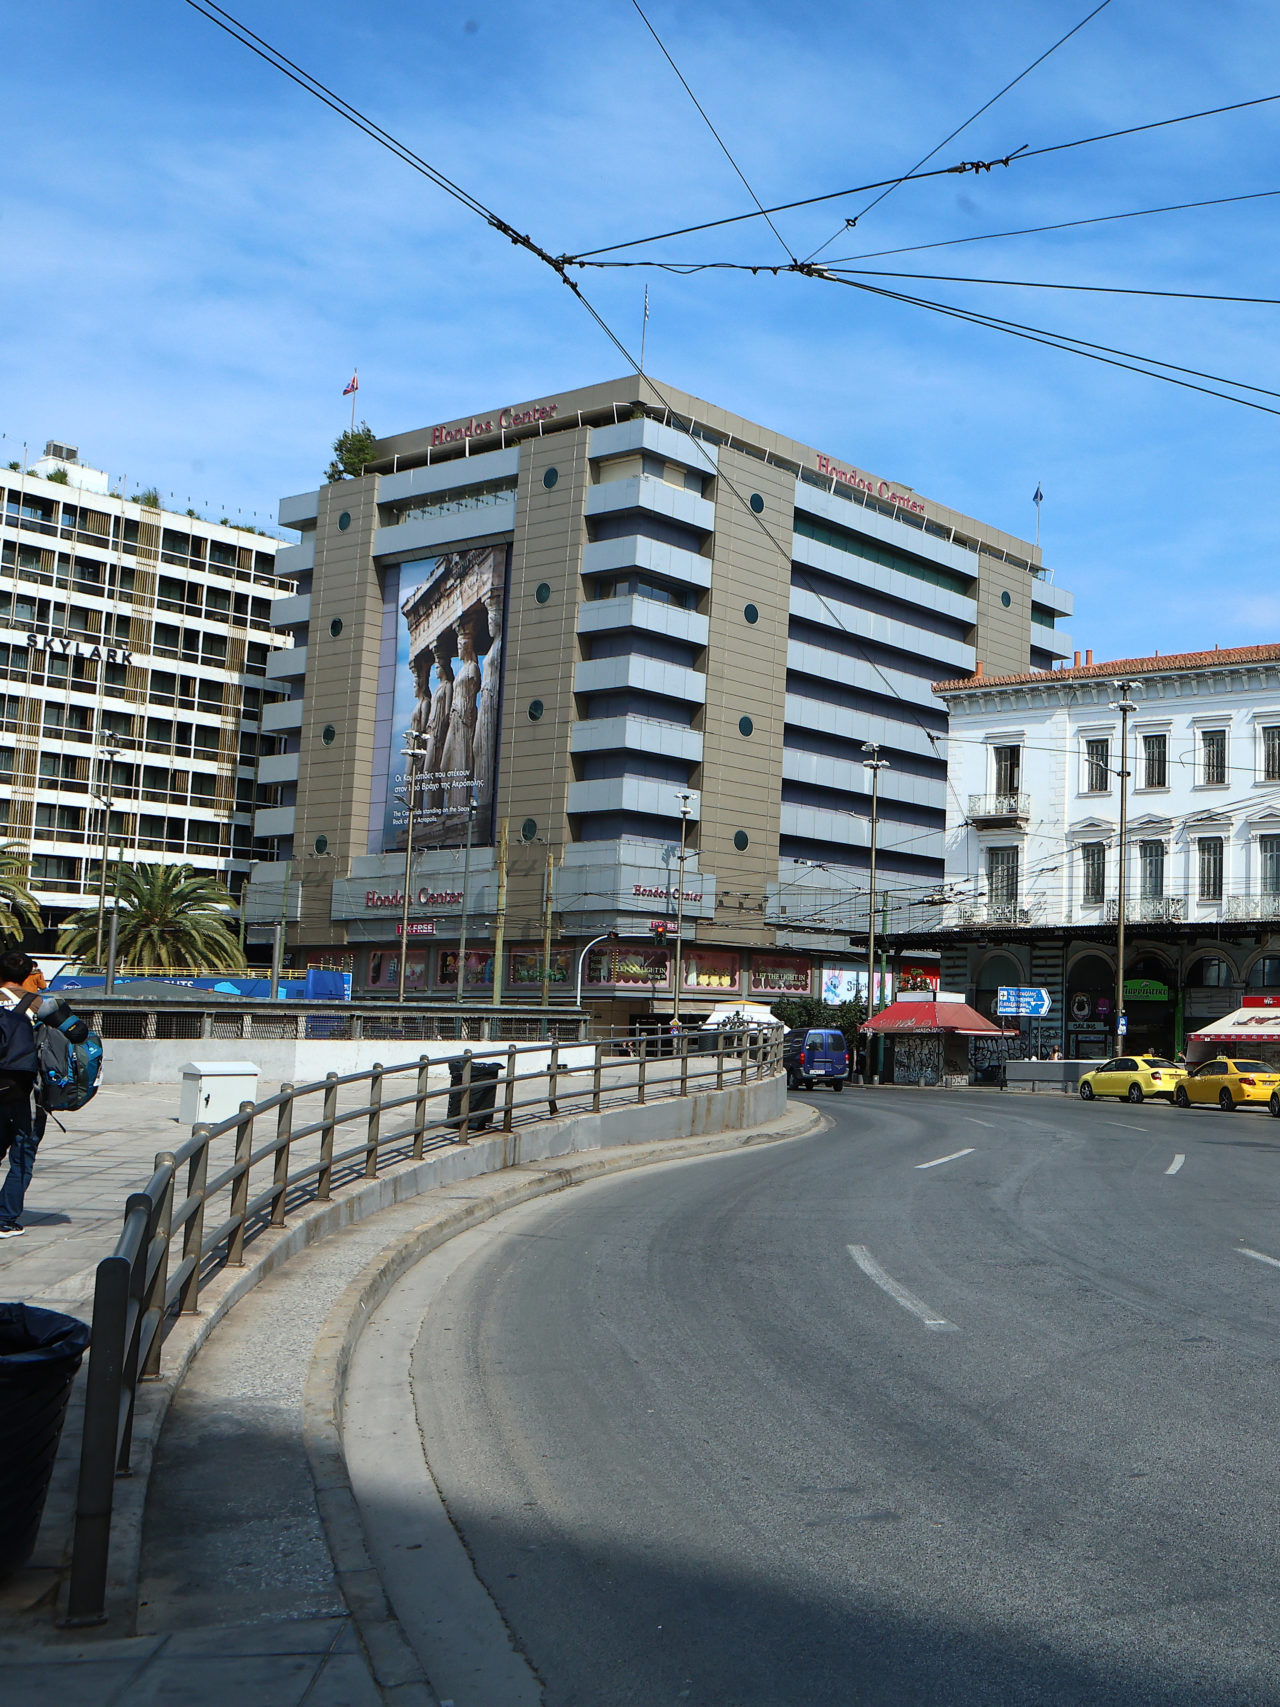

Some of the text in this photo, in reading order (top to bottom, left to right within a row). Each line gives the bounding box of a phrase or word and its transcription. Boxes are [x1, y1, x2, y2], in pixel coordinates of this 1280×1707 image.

[432, 403, 558, 446] Hondos Center
[816, 454, 925, 513] Hondos Center
[26, 633, 133, 665] SKYLARK
[421, 781, 439, 792] Βράχο
[423, 807, 441, 815] standing
[419, 887, 465, 905] Center
[633, 884, 670, 899] Hondos
[412, 923, 433, 933] FREE
[780, 973, 798, 981] LIGHT
